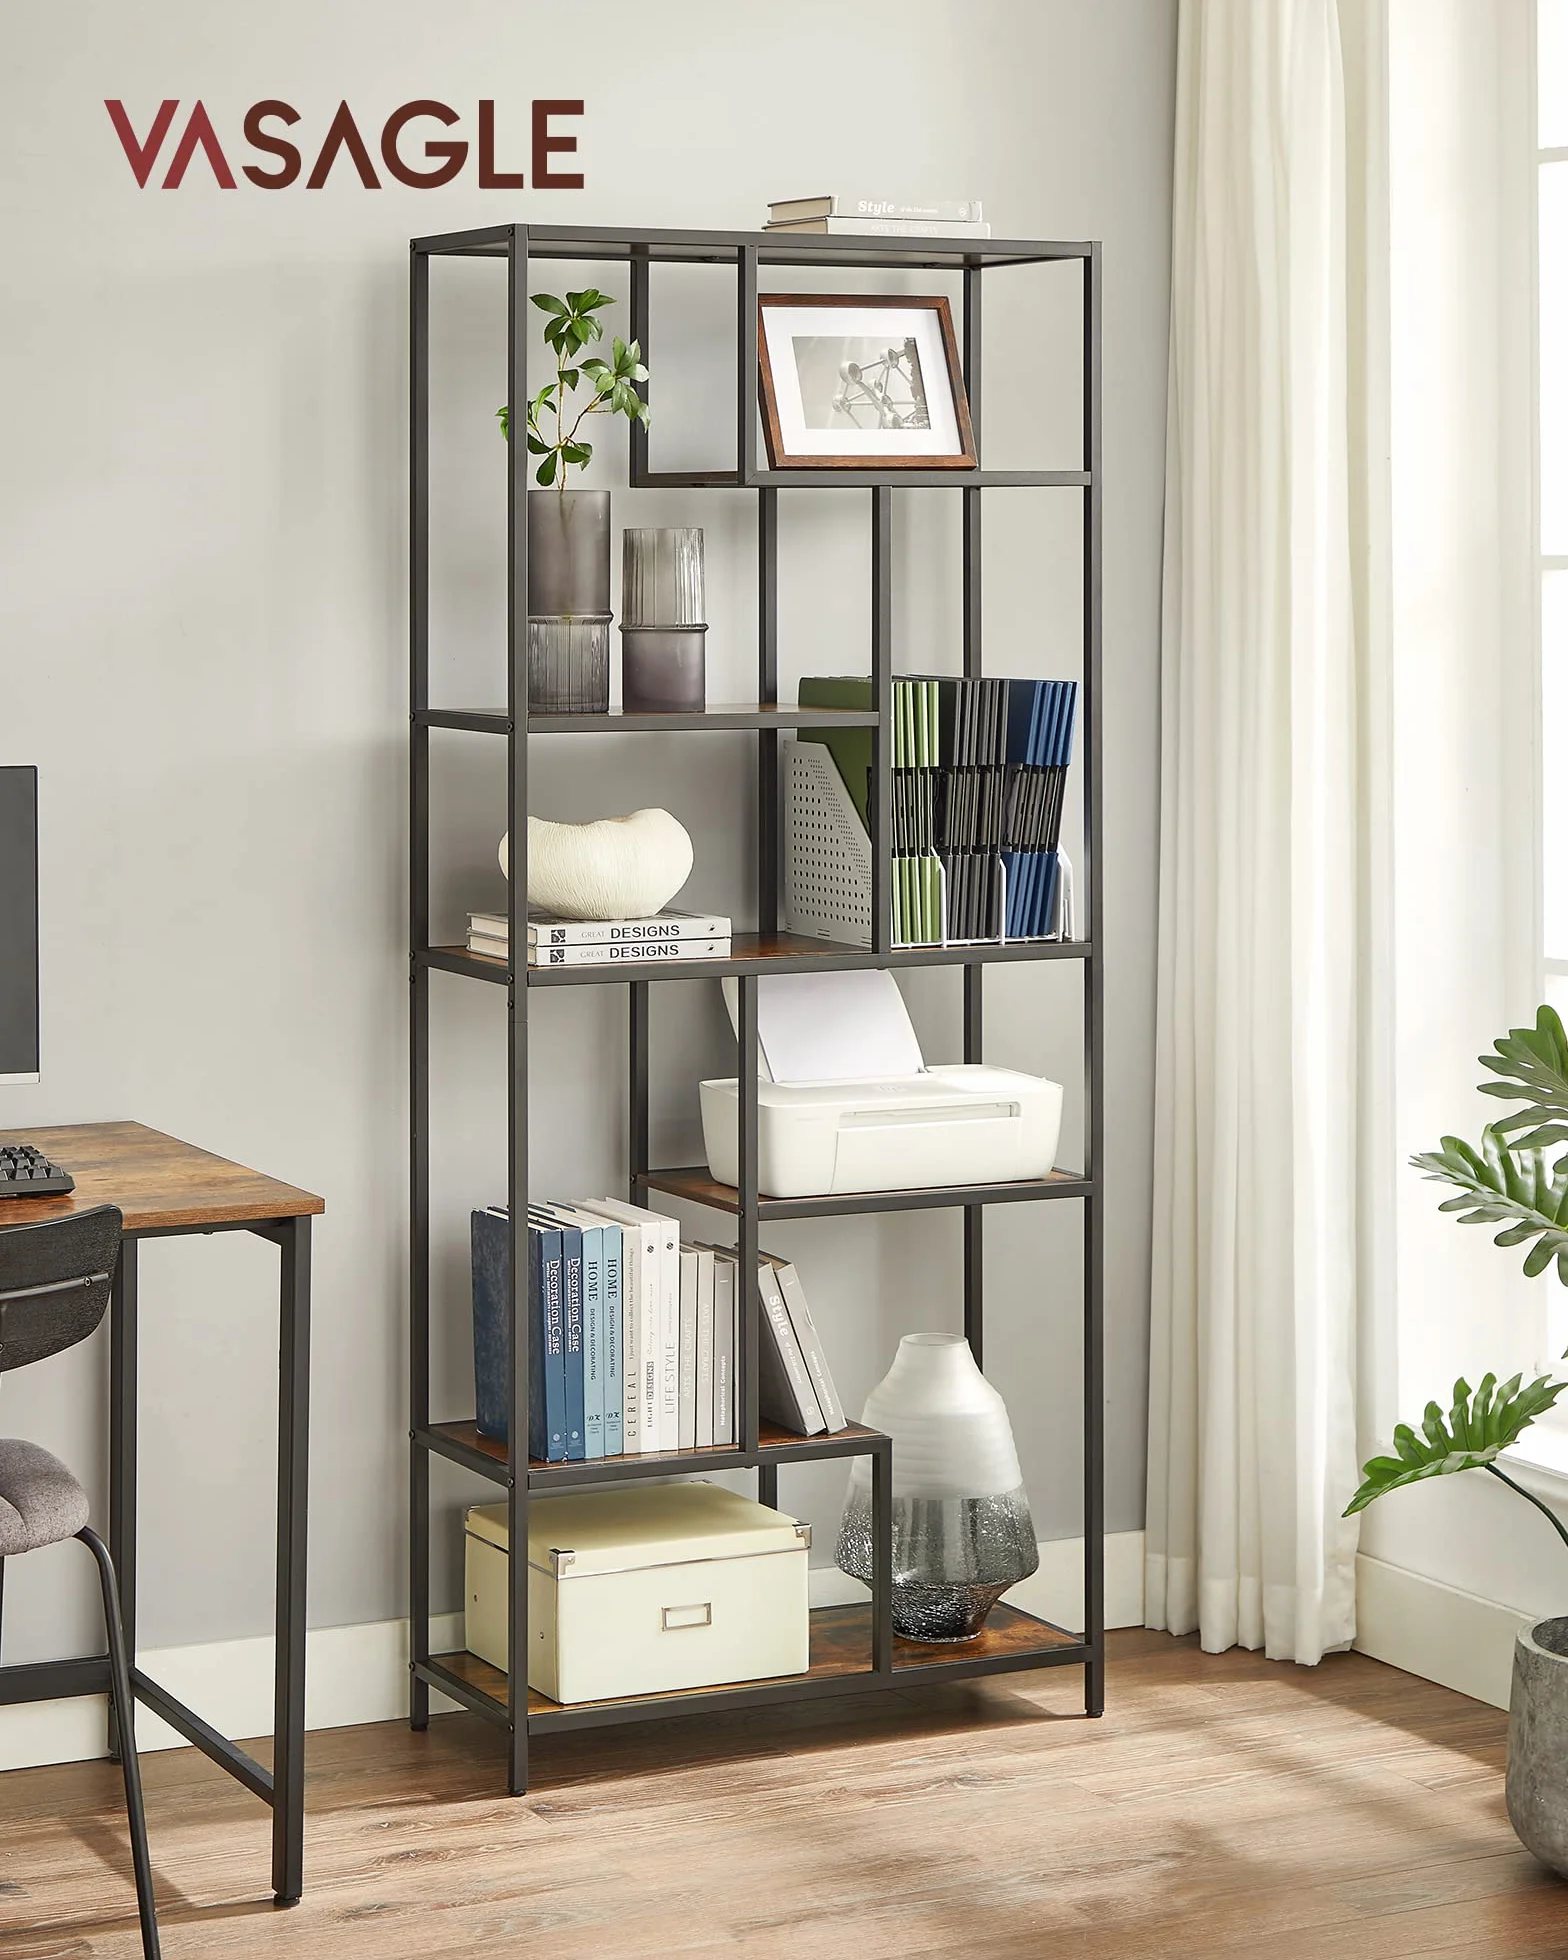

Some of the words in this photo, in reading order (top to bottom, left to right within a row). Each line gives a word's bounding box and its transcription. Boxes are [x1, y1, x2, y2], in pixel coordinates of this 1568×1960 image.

[858, 200, 895, 215] Style
[580, 950, 604, 958] GREAT
[609, 944, 679, 958] DESIGNS
[581, 931, 605, 939] GREAT
[610, 924, 680, 939] DESIGNS
[550, 1259, 560, 1324] Decoration
[570, 1258, 580, 1322] Decoration
[588, 1260, 598, 1302] HOME
[607, 1259, 617, 1299] HOME
[684, 1318, 692, 1350] CRAFTS
[769, 1295, 789, 1336] Style
[551, 1326, 561, 1355] Case
[571, 1324, 581, 1352] Case
[589, 1338, 597, 1381] DECORATING
[627, 1371, 637, 1437] CEREAL
